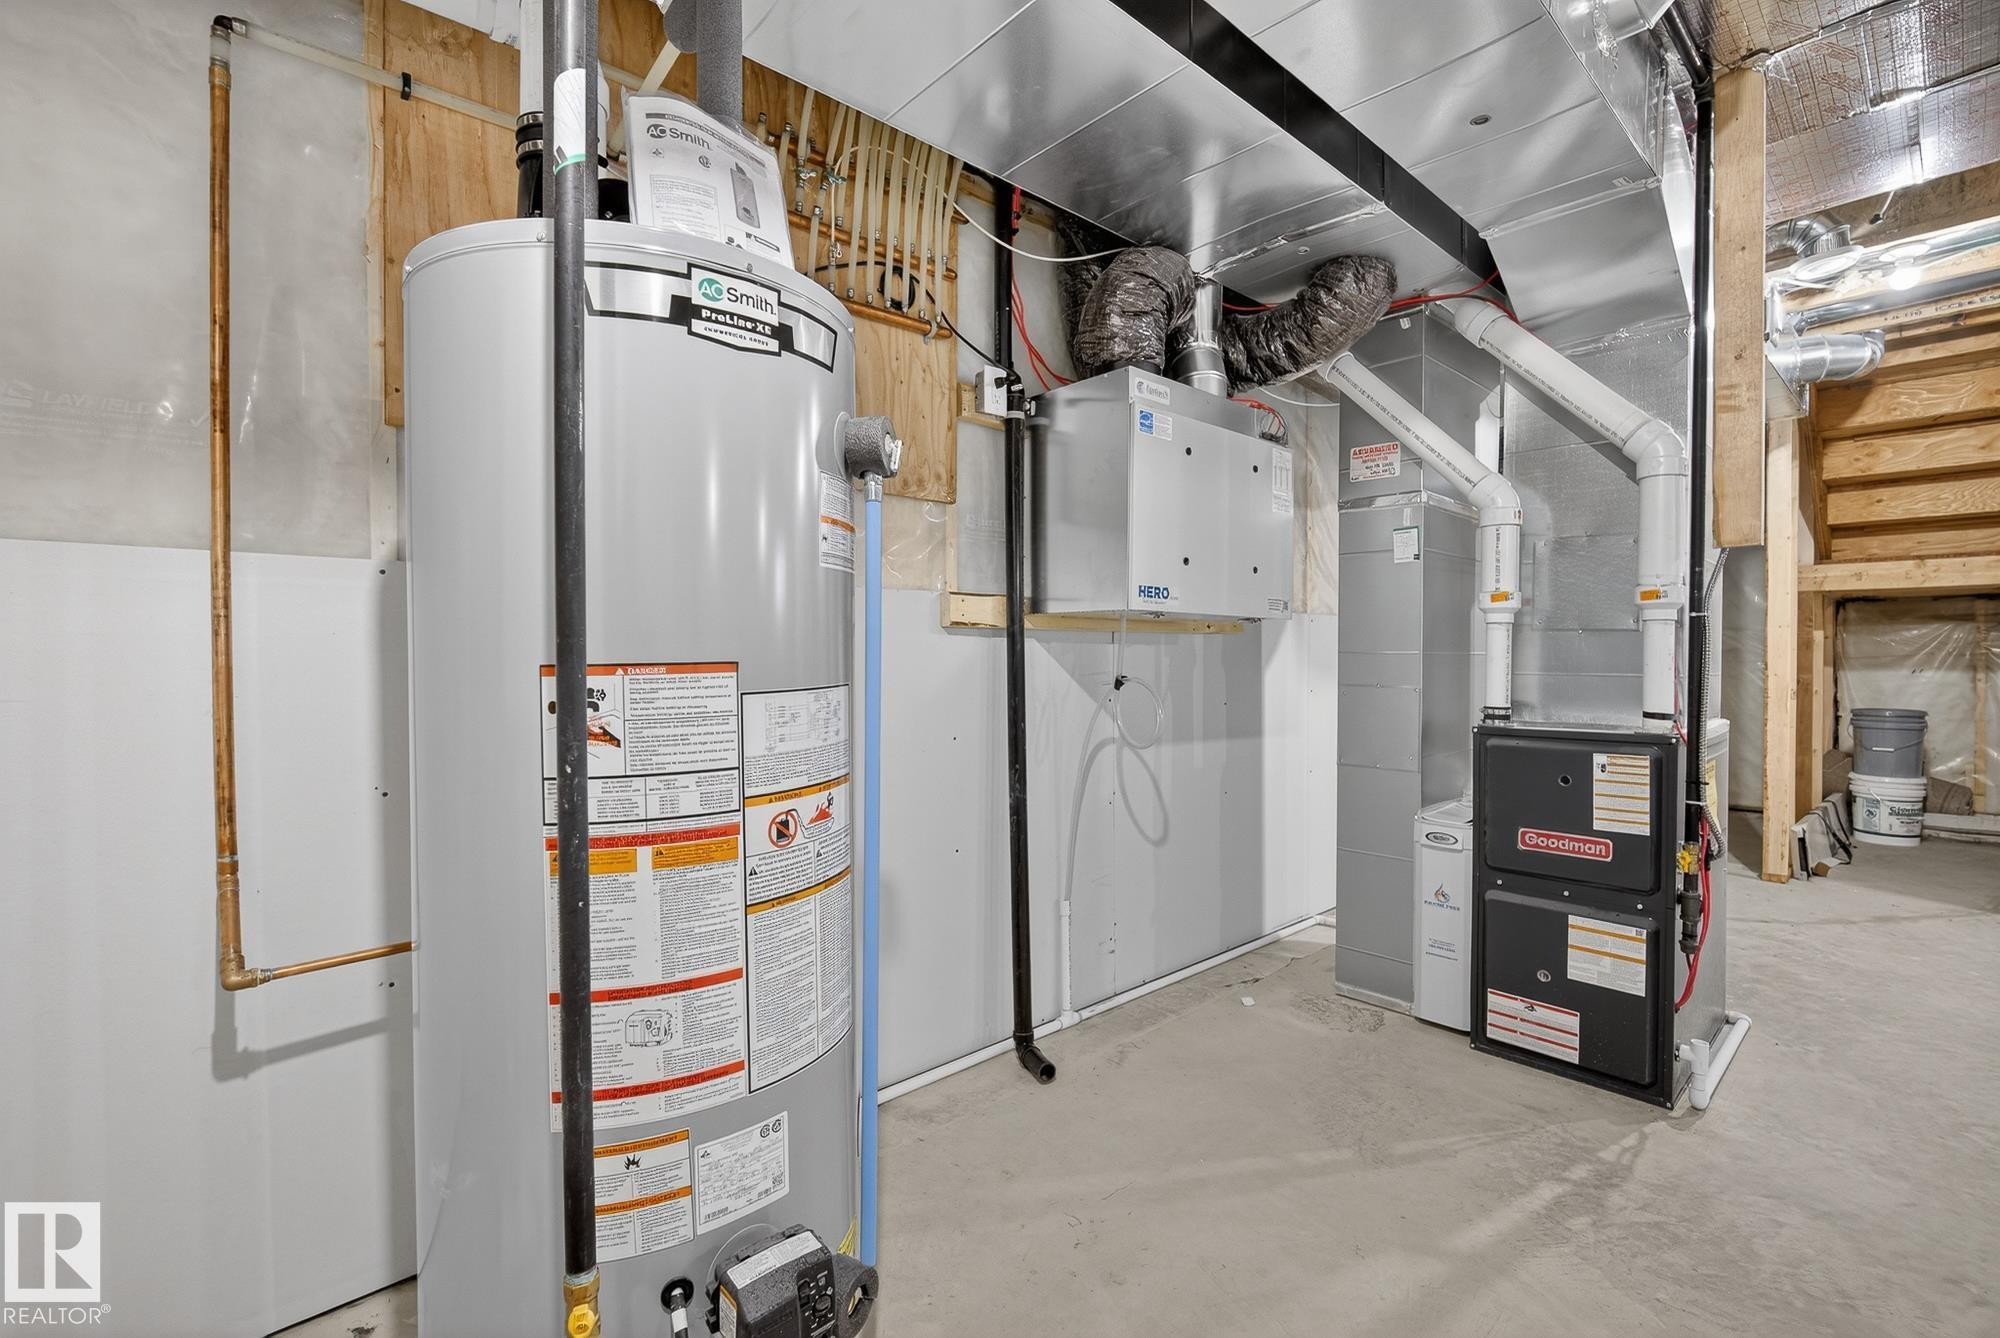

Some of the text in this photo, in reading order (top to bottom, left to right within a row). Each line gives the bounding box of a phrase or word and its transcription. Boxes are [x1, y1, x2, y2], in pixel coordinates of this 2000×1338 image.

[698, 279, 724, 302] AO
[1138, 584, 1170, 600] HERO
[1524, 833, 1606, 856] Goodman
